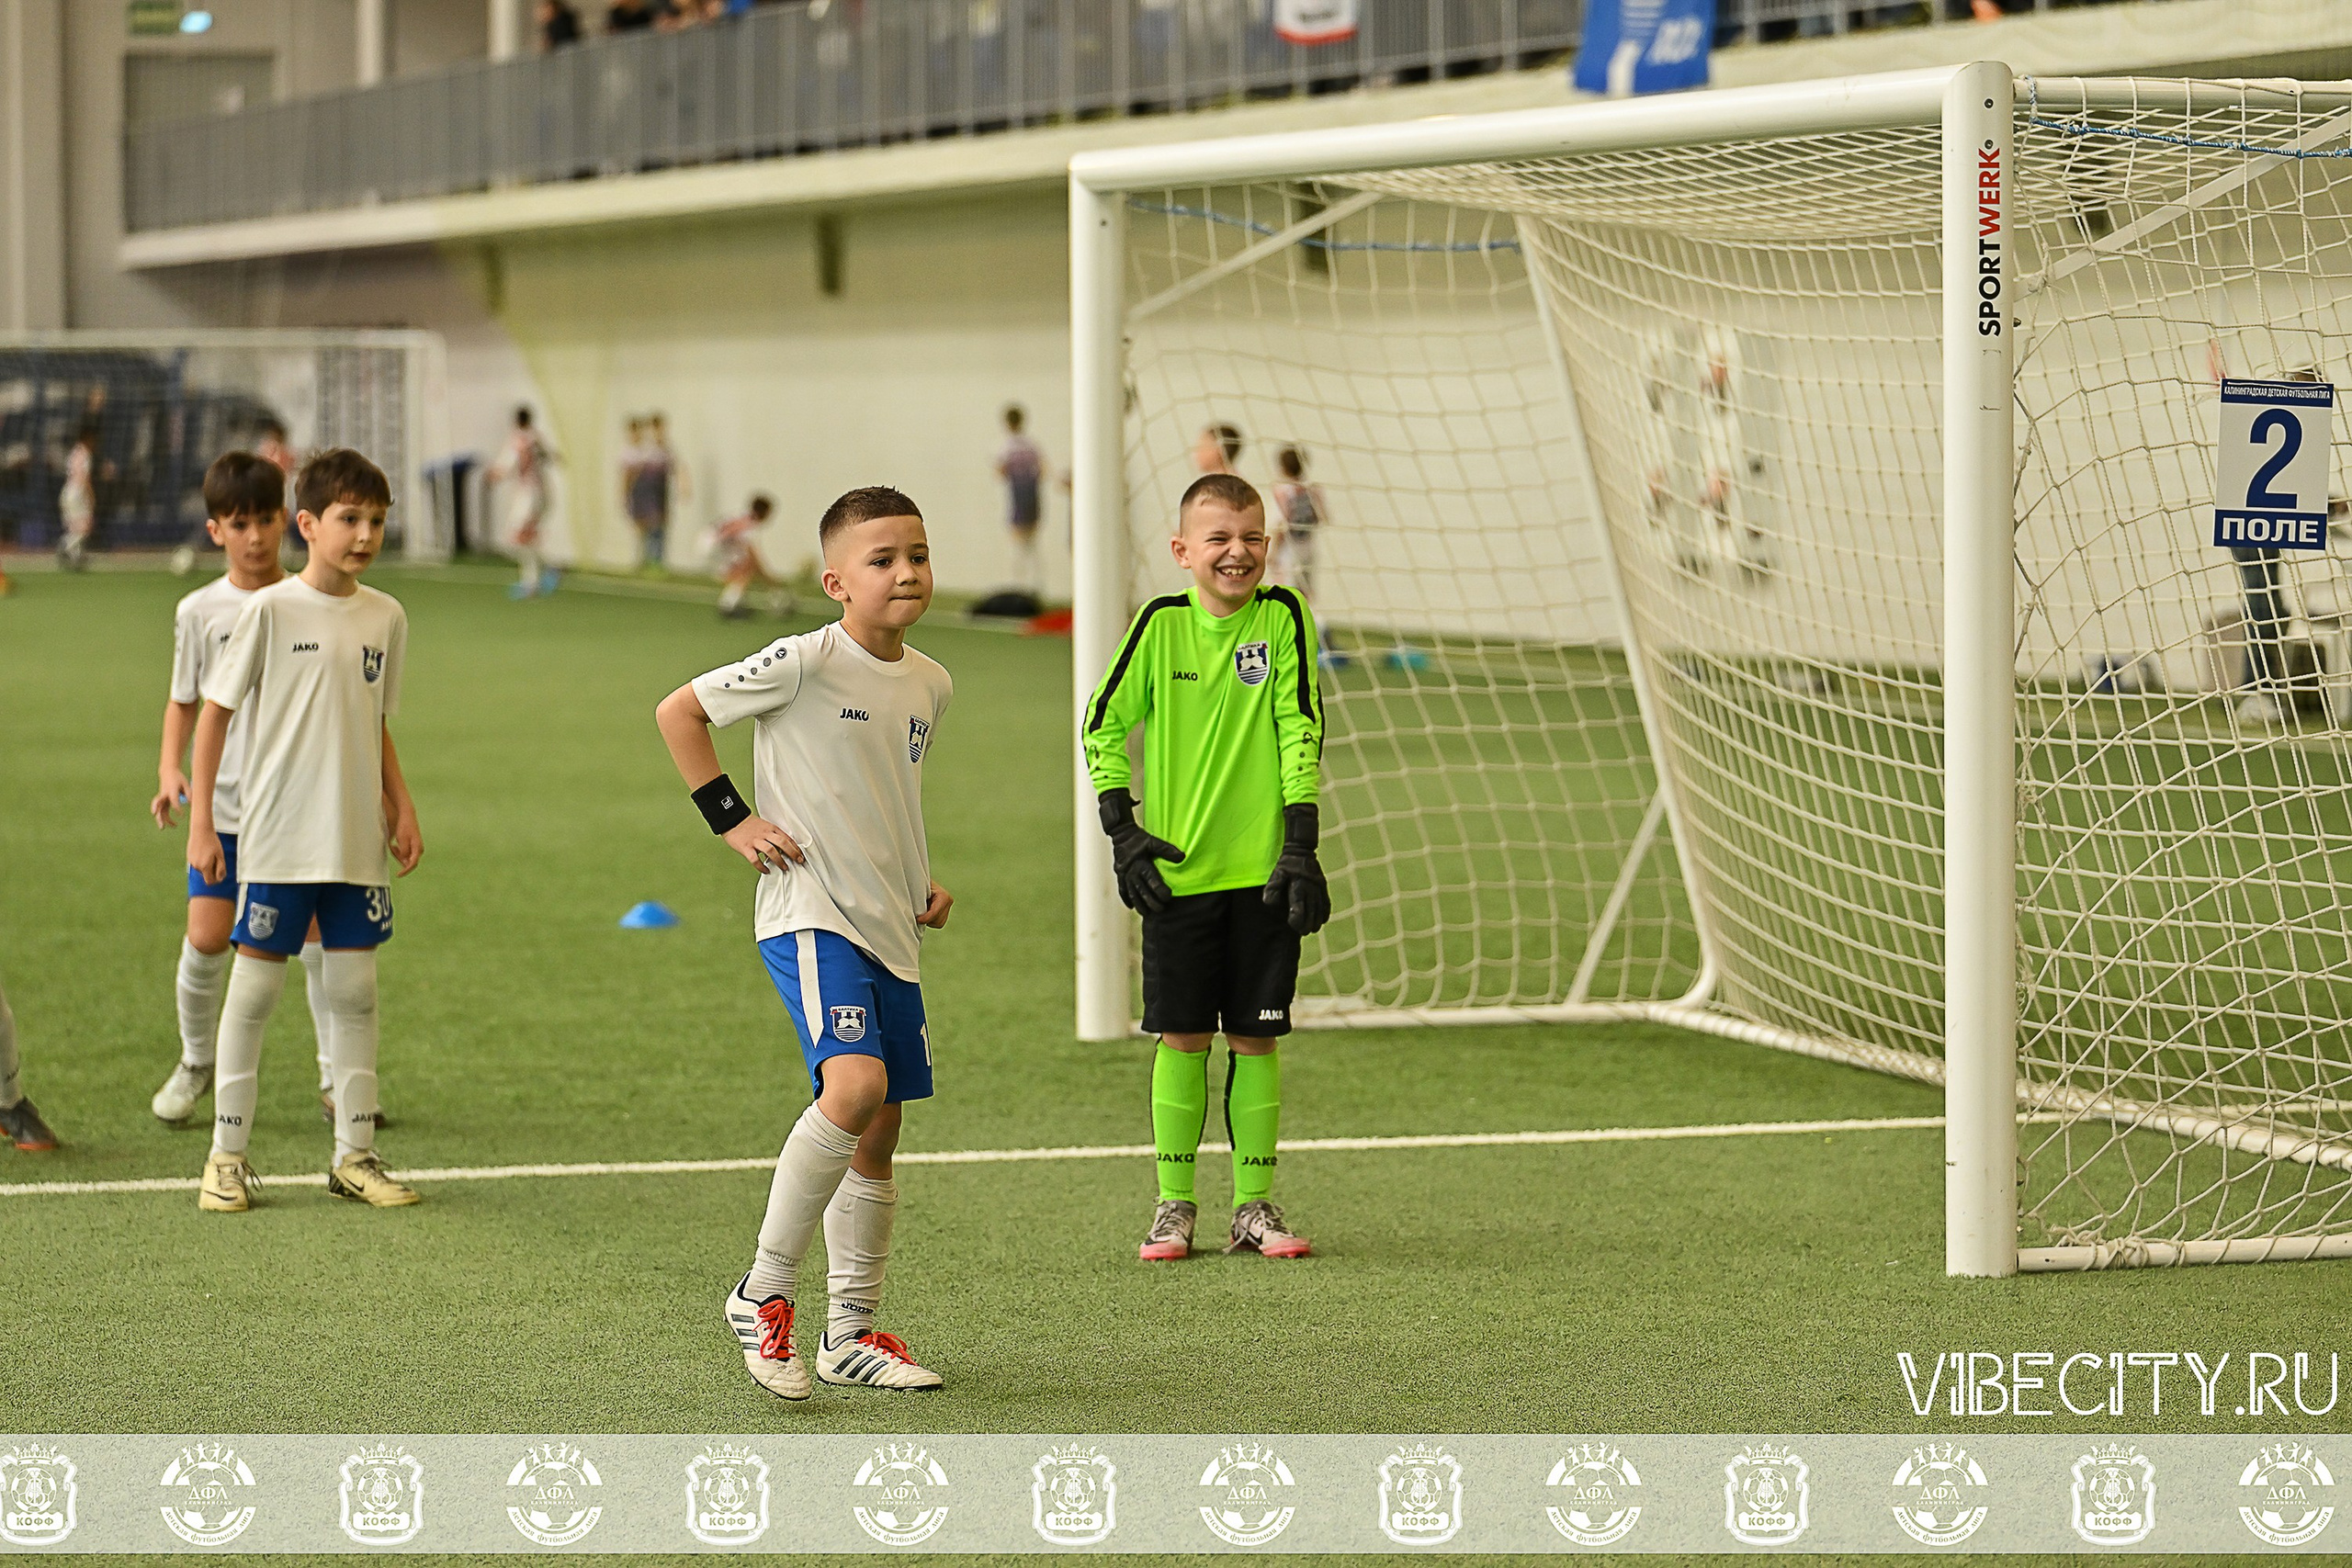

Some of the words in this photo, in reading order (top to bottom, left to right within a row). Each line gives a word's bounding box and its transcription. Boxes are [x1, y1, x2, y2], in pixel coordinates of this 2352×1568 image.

[1979, 147, 2001, 336] SPORTWERK
[2224, 387, 2267, 397] КАЛИНИНГРАДСКАЯ
[2267, 389, 2288, 397] ДЕТСКАЯ
[2289, 389, 2318, 399] ФУТБОЛЬНАЯ
[2319, 390, 2331, 399] ЛИГА
[2246, 409, 2302, 509] 2
[2222, 517, 2319, 543] ПОЛЕ
[292, 642, 319, 652] JAKO
[1172, 671, 1198, 681] JAKO
[840, 708, 869, 721] JAKO
[1259, 1010, 1283, 1021] JAKO
[218, 1113, 243, 1128] AKO
[1157, 1153, 1194, 1163] JAKO
[1242, 1156, 1277, 1167] JAKO
